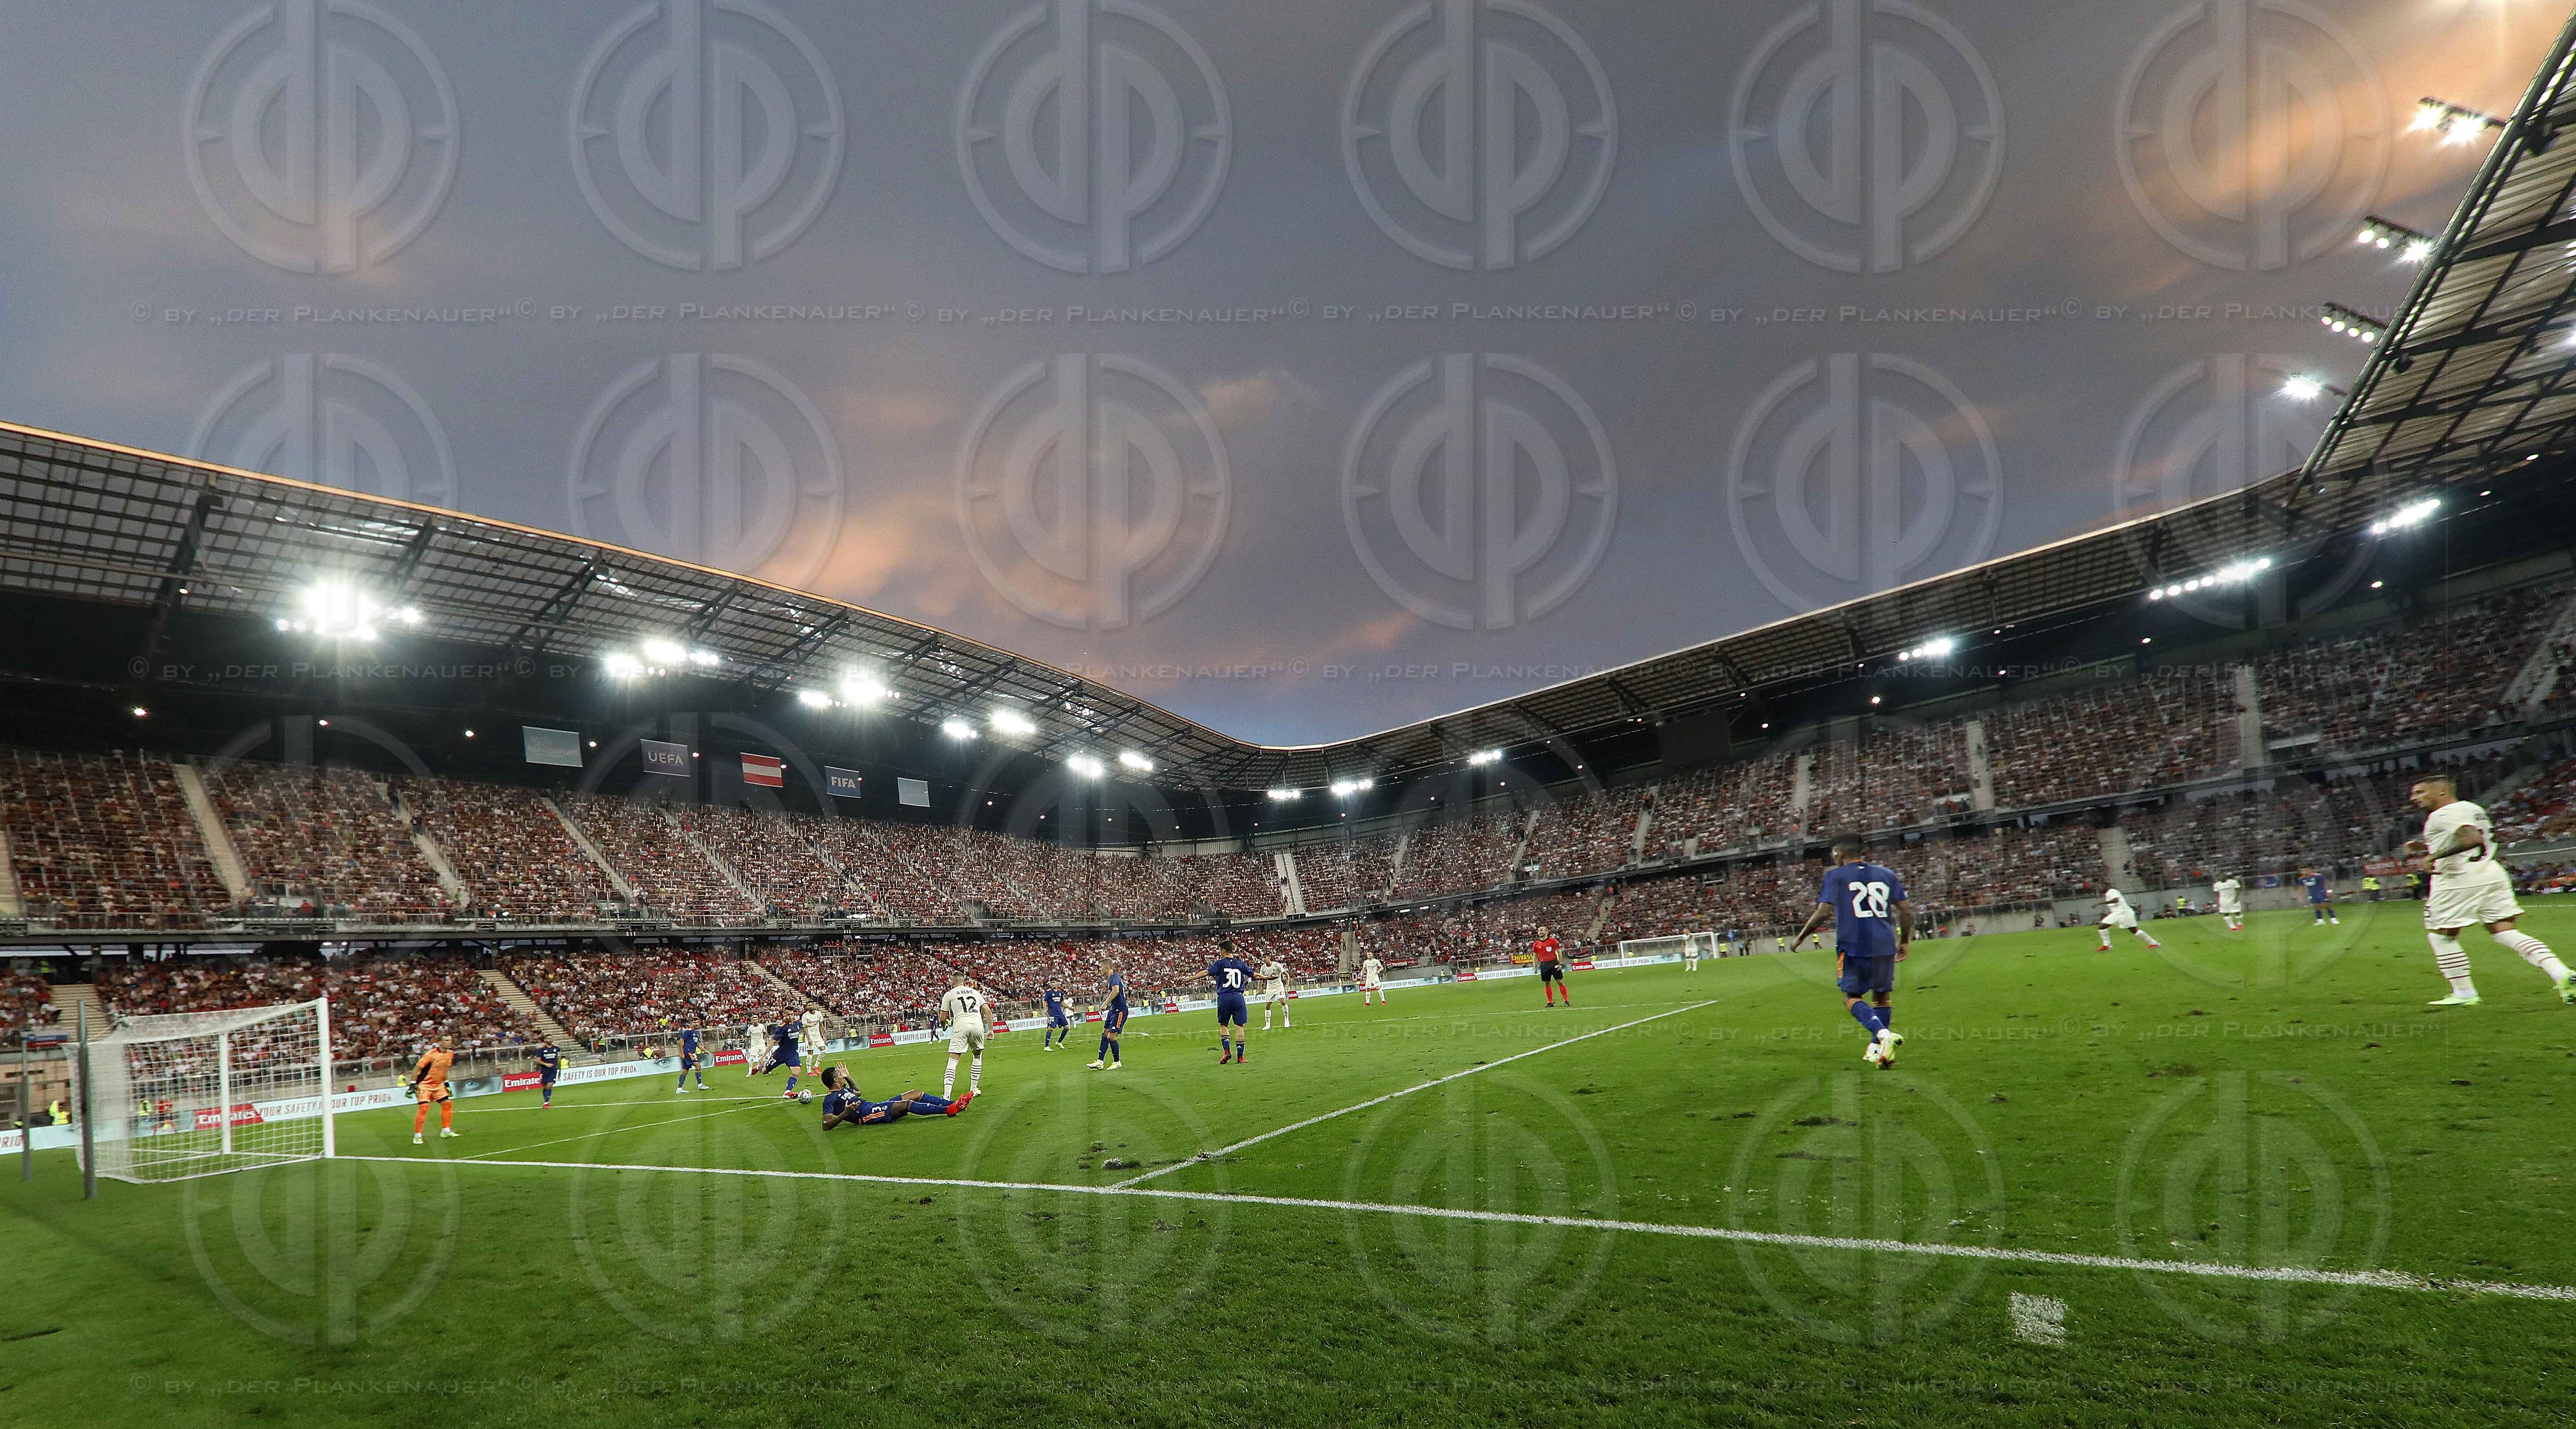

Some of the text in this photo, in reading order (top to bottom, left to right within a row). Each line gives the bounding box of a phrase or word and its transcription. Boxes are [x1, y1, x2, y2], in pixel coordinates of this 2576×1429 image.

[648, 752, 683, 765] UEFA
[831, 776, 856, 789] FIFA
[1848, 881, 1890, 918] 28
[1222, 968, 1241, 988] 30
[957, 996, 978, 1013] 12
[716, 1054, 744, 1063] Emirates
[563, 1071, 585, 1081] SAFETY
[586, 1070, 593, 1078] IS
[594, 1068, 606, 1077] OUR
[608, 1067, 619, 1076] TOP
[504, 1077, 541, 1088] Emirate
[284, 1102, 315, 1114] SAFETY
[350, 1095, 365, 1107] TOP
[198, 1110, 256, 1124] Emates
